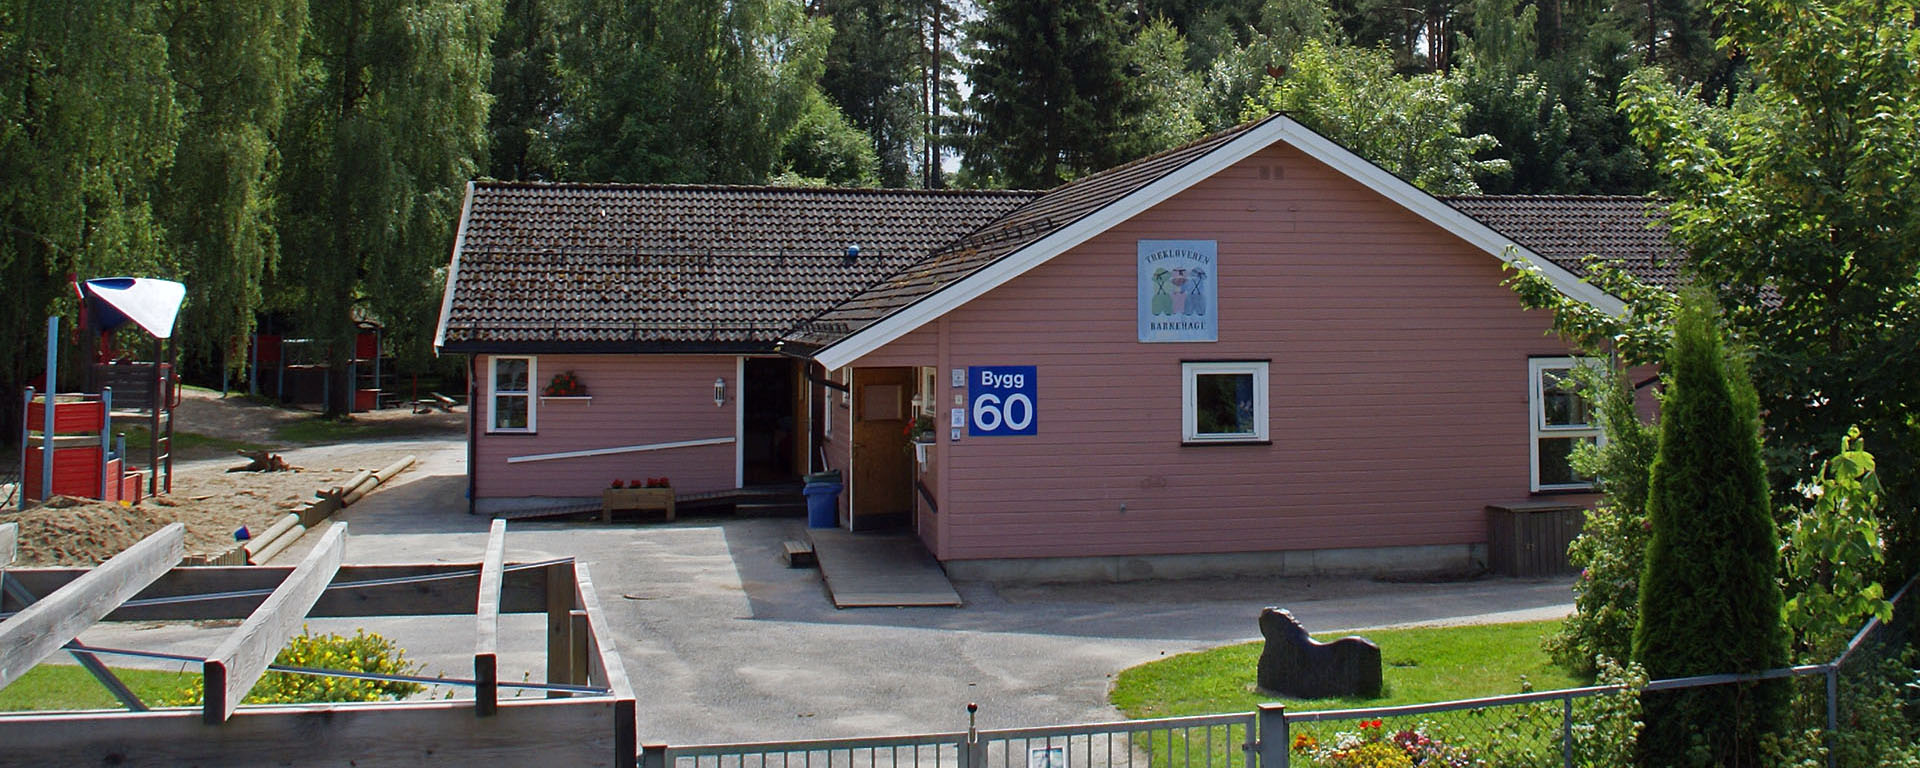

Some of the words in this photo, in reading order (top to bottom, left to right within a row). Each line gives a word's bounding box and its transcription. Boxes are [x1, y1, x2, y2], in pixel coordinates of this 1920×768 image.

[1150, 321, 1206, 331] BARNEHAGE
[981, 371, 1024, 388] Bygg
[973, 393, 1033, 431] 60
